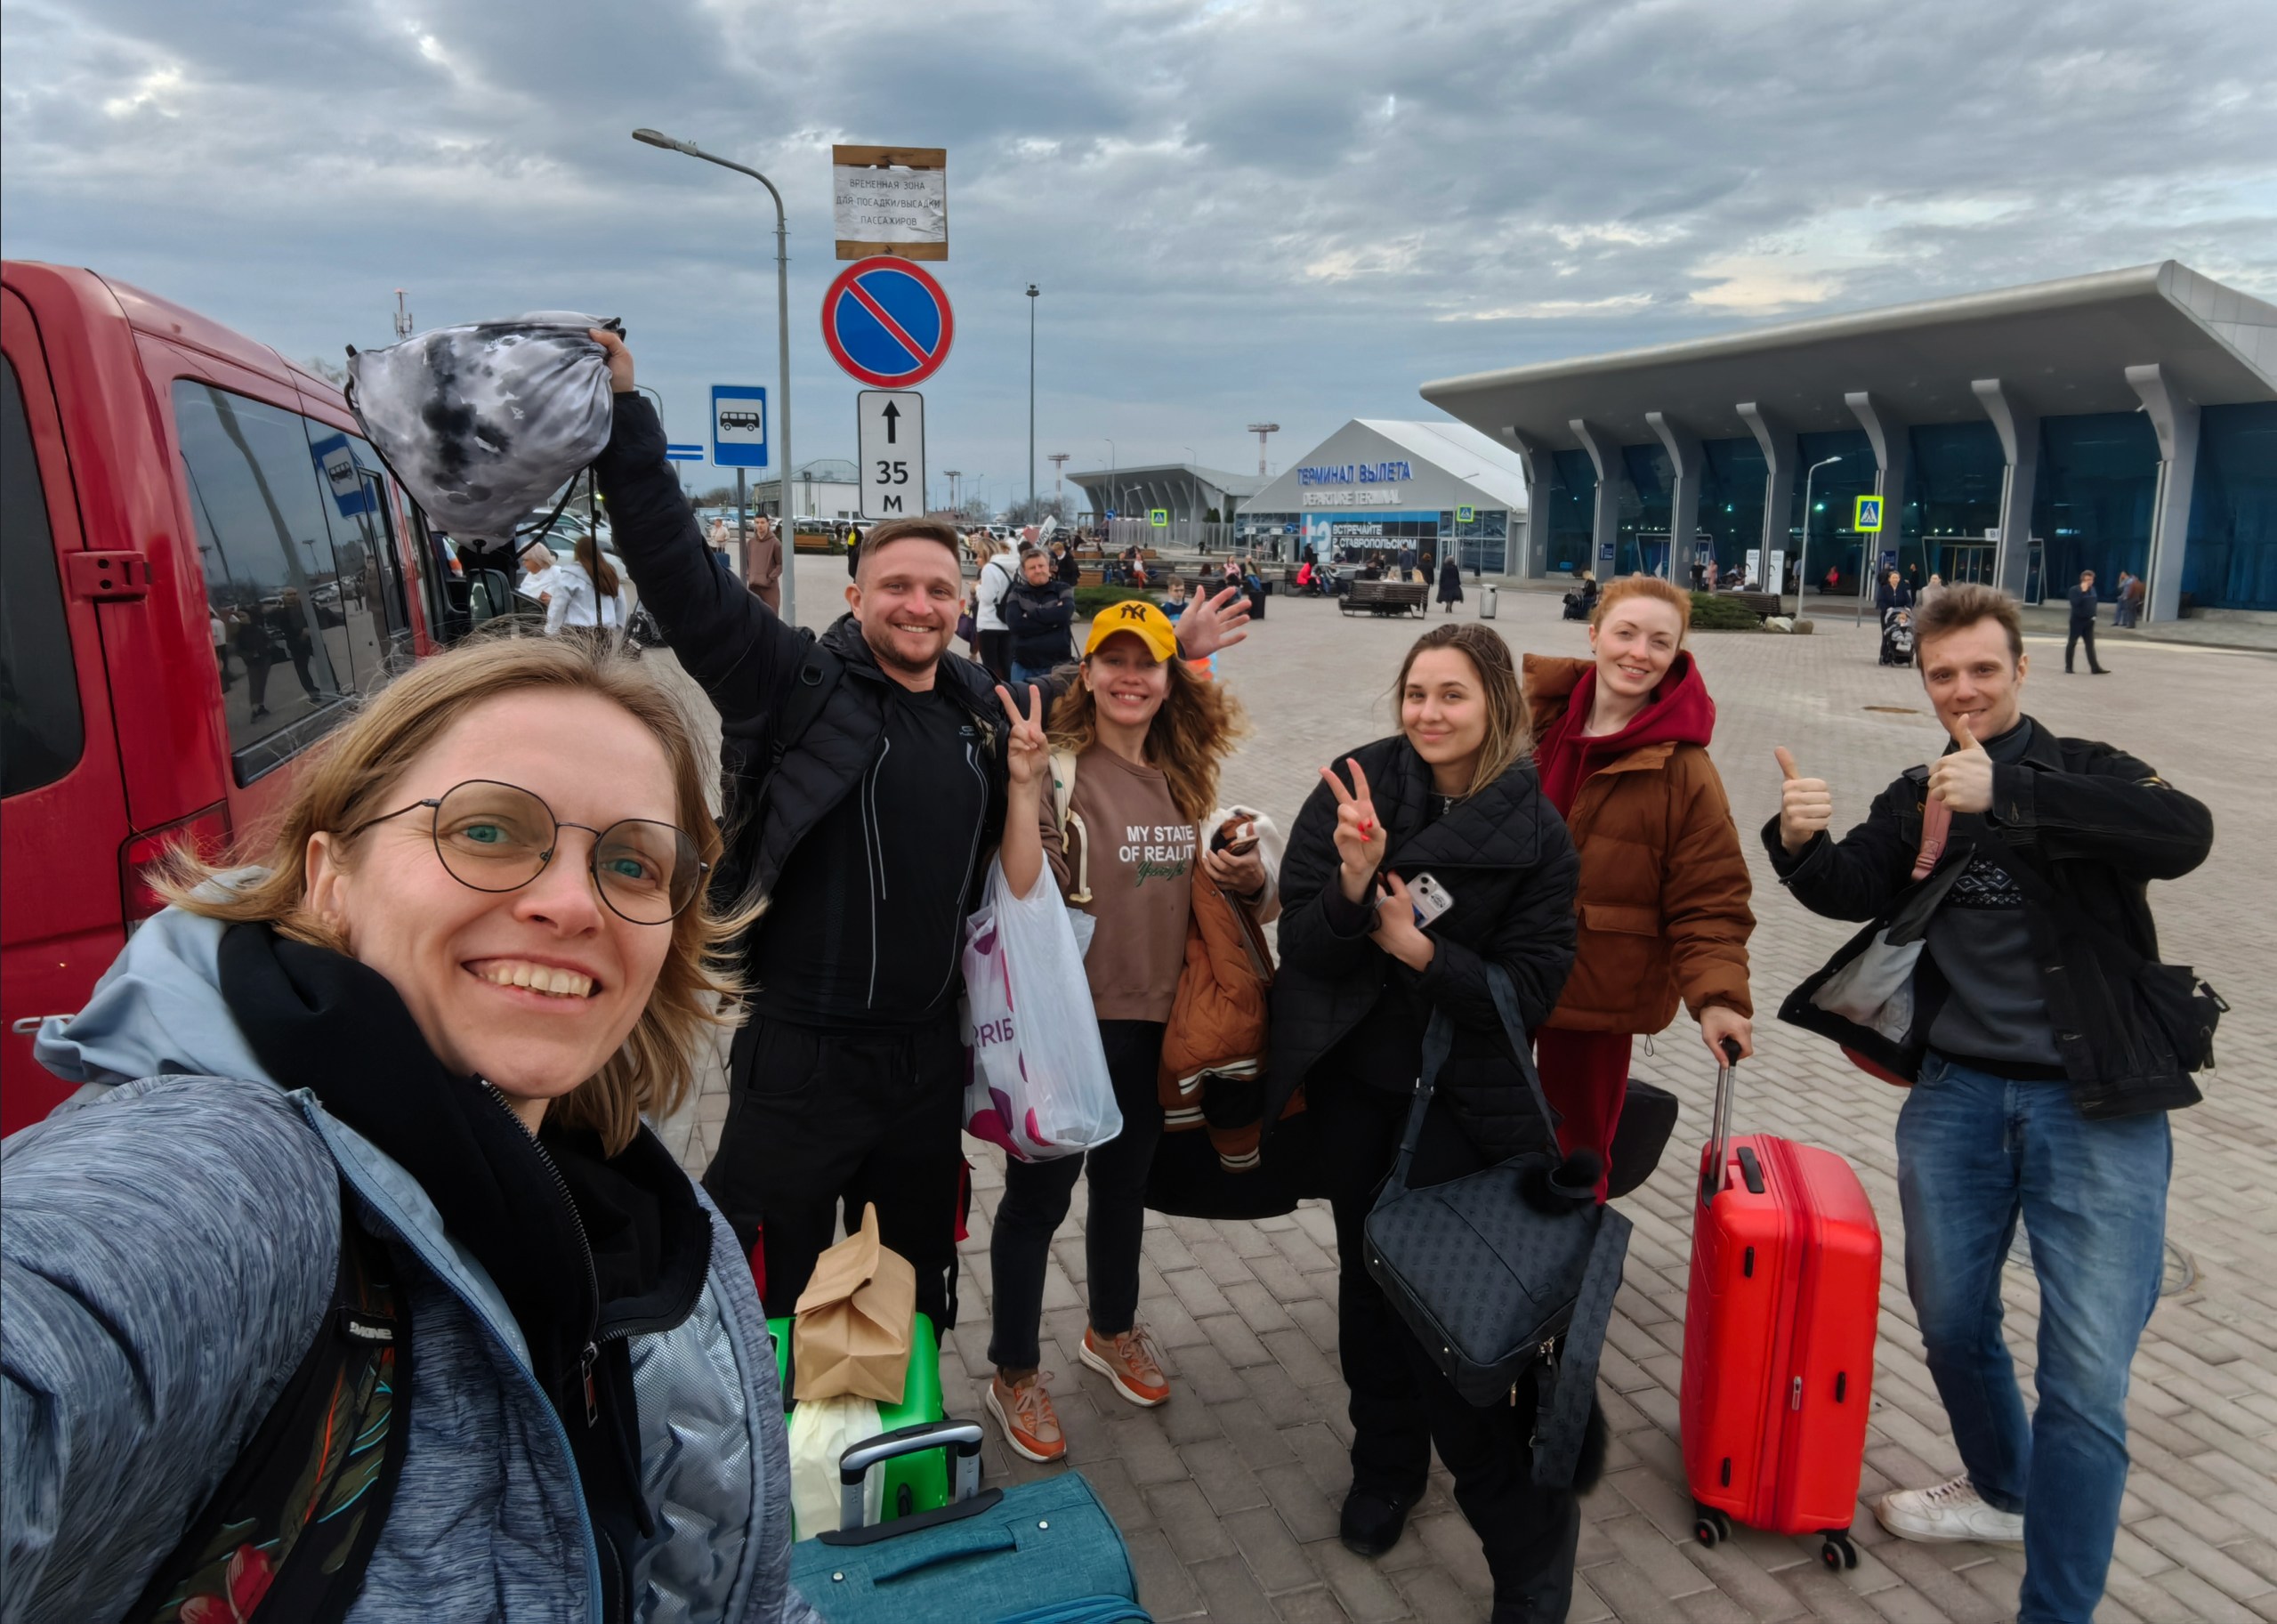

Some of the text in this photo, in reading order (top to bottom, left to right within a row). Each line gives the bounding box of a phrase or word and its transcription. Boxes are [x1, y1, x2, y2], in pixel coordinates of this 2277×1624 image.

[850, 179, 925, 190] ВРЕМЕННАЯ ЗОНА
[836, 196, 941, 208] ДЛЯ ПОСАДКИ/ВЫСАДКИ
[860, 215, 917, 226] ПАССАЖИРОВ
[876, 460, 908, 485] 35
[1297, 461, 1413, 485] ТЕРМИНАЛ ВЫЛЕТА
[1303, 489, 1402, 506] DEPARTURE TERMINAL
[1333, 521, 1382, 536] ВСТРЕЧАЙТЕ
[1339, 538, 1417, 550] СТАВРОПОЛЬСКОМ
[1126, 825, 1195, 842] MY STATE
[1119, 844, 1196, 862] OF REALIT
